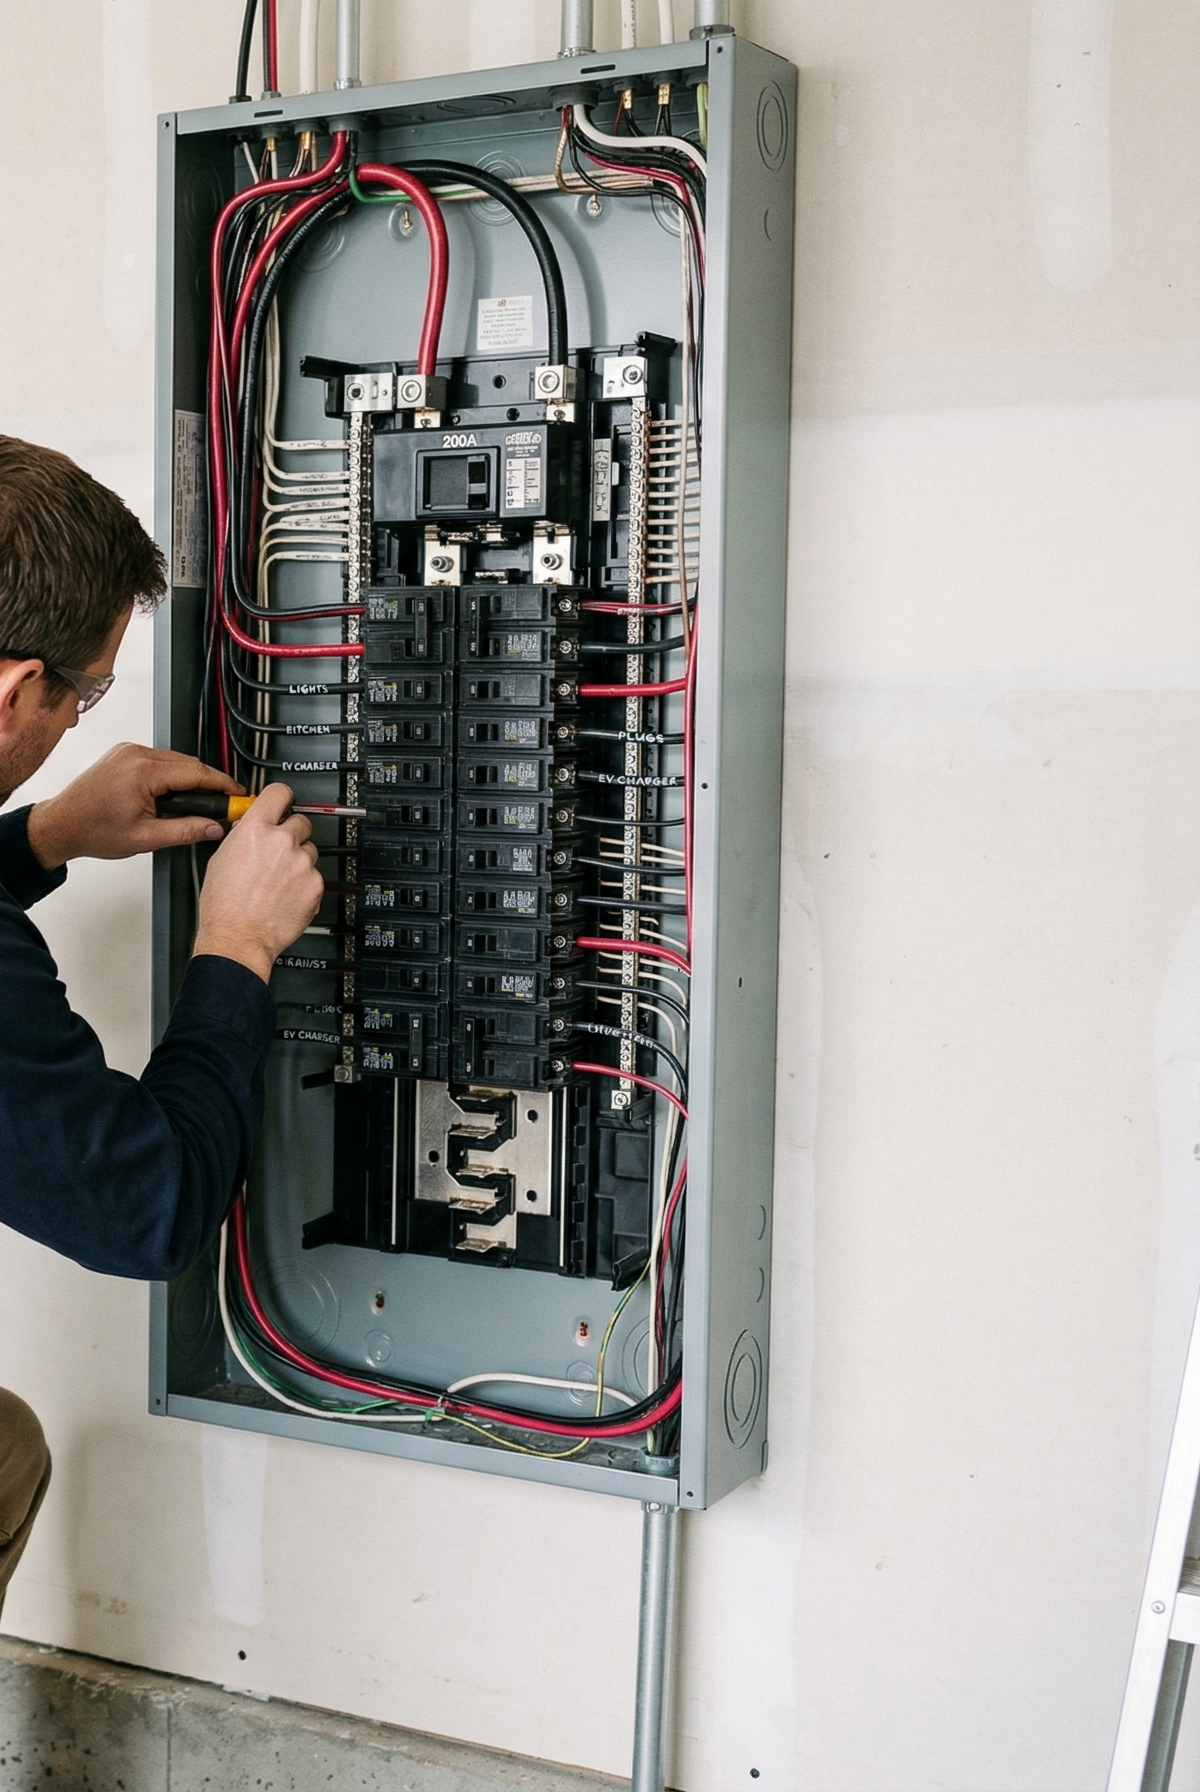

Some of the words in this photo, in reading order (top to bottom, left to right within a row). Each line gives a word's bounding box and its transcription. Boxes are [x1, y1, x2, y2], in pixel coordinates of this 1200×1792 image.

[442, 433, 478, 448] 200A
[289, 684, 329, 694] LIGHTS
[618, 730, 665, 744] PLUGS
[283, 1030, 296, 1039] EV
